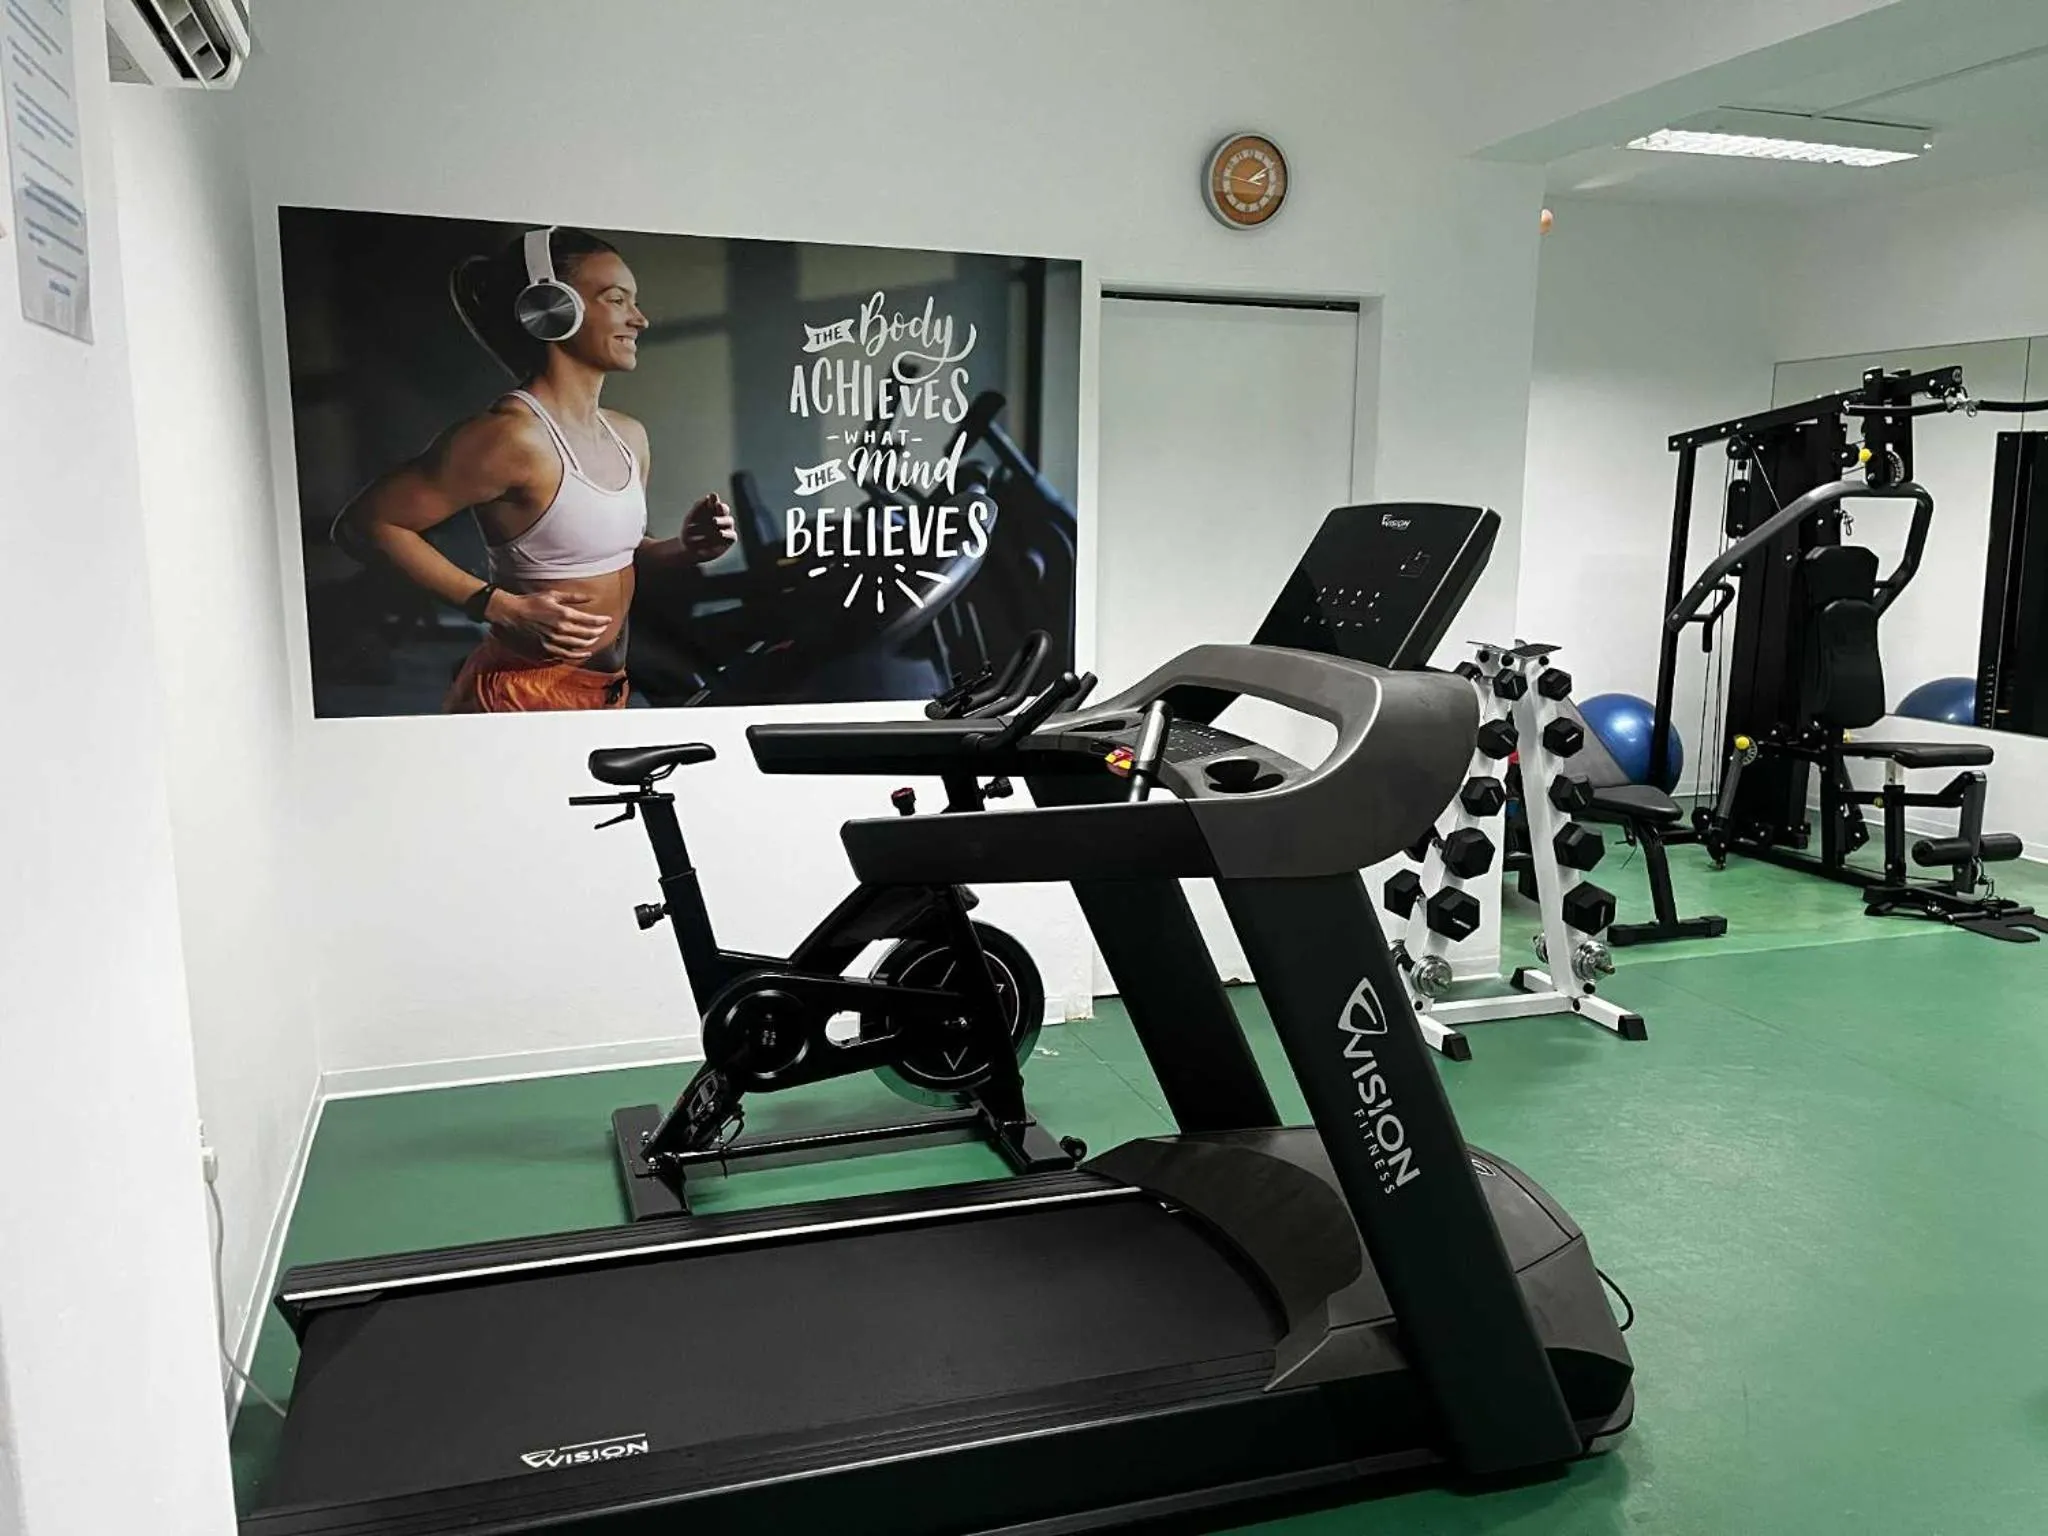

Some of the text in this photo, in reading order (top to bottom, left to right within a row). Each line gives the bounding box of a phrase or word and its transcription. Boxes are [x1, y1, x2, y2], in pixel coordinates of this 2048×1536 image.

[814, 291, 977, 384] THE Body
[789, 356, 969, 424] ACHIEVES
[805, 431, 967, 495] THE Mind
[844, 430, 909, 444] WHAT
[786, 501, 988, 559] BELIEVES
[1343, 1034, 1421, 1187] VISION
[1353, 1108, 1395, 1194] FITNESS
[547, 1440, 649, 1467] VISION
